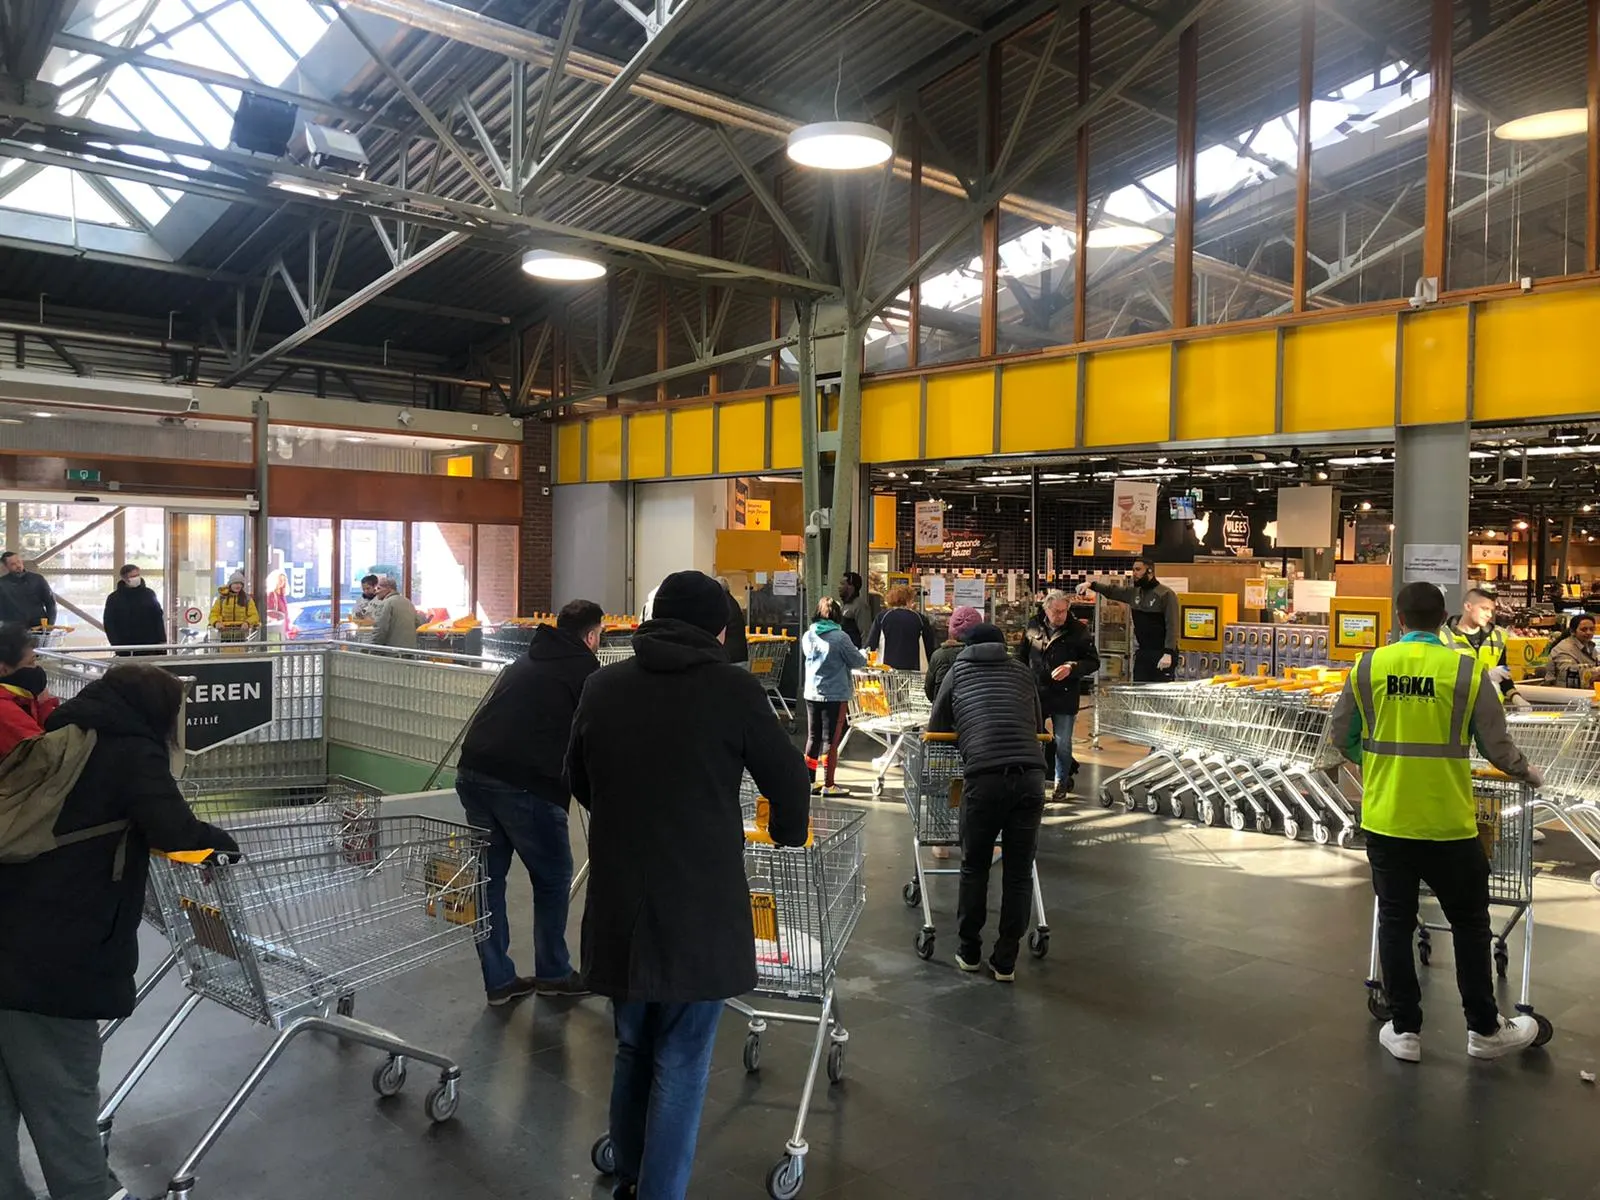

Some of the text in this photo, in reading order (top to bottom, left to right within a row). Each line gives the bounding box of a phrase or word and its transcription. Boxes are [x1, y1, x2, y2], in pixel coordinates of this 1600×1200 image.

[1226, 520, 1247, 533] VLEES
[954, 539, 981, 550] gezonde
[186, 682, 261, 703] EREN
[1386, 675, 1435, 697] BOKA
